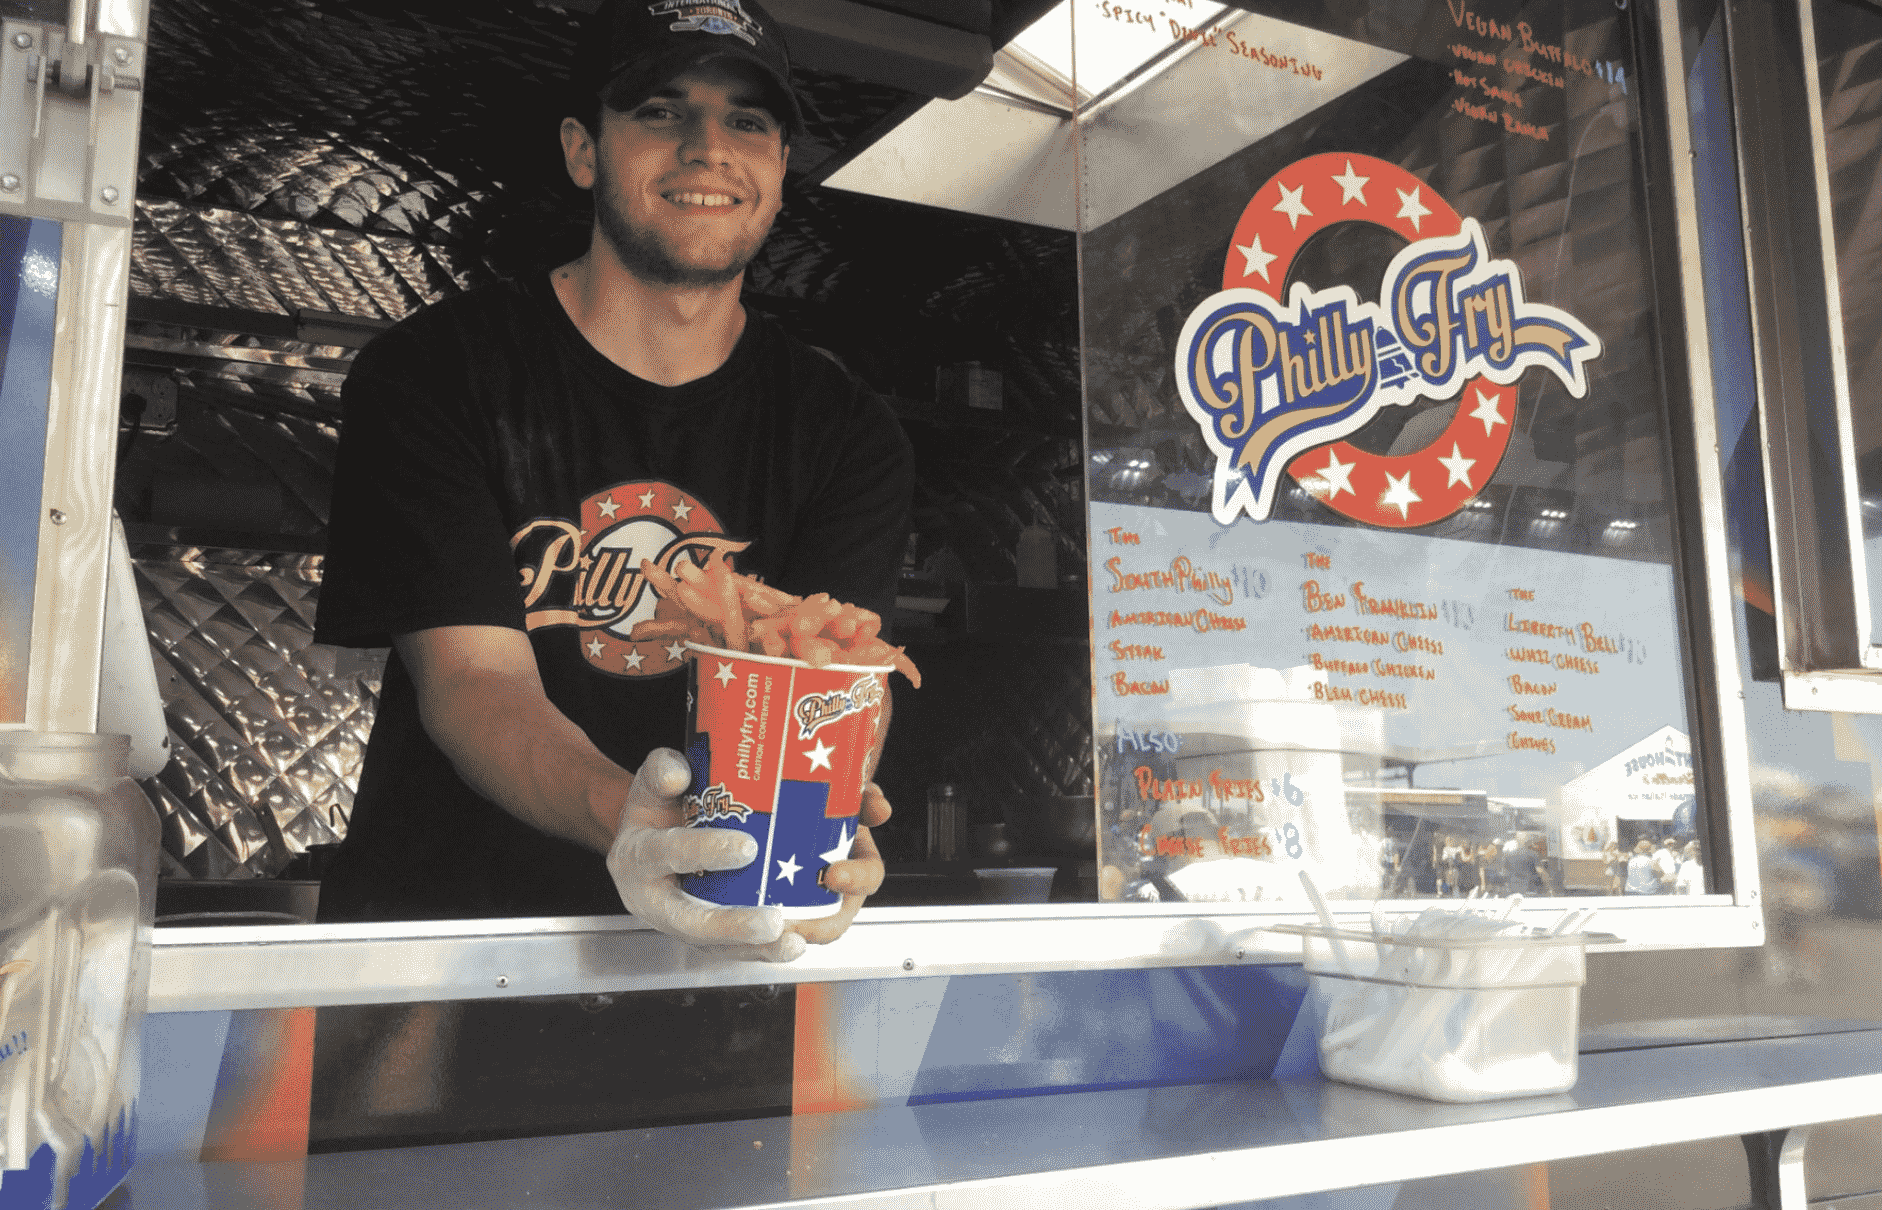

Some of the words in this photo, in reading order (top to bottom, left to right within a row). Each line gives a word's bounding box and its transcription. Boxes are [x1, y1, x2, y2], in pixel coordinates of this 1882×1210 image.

[1190, 300, 1376, 468] Philly
[1394, 247, 1572, 382] Fry
[735, 673, 759, 780] phillyfry.com
